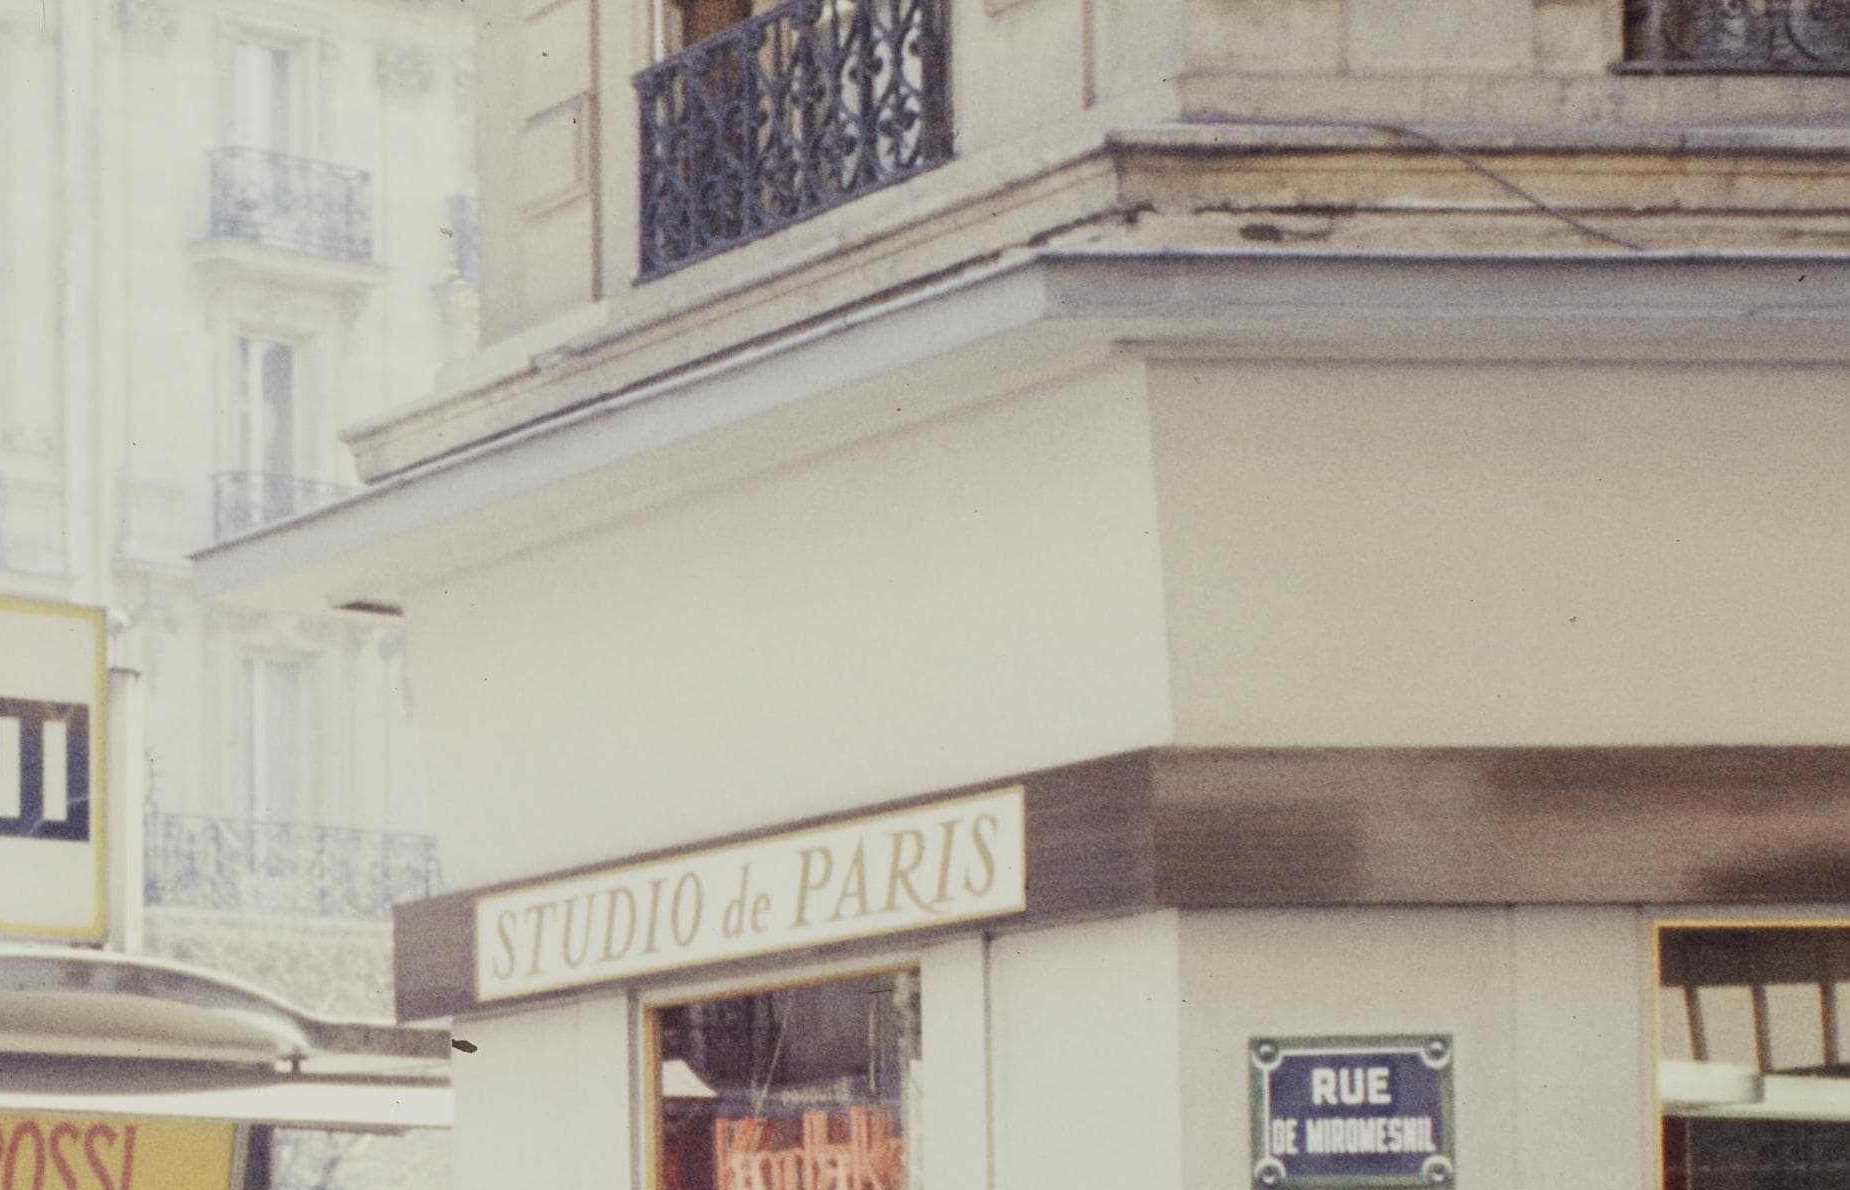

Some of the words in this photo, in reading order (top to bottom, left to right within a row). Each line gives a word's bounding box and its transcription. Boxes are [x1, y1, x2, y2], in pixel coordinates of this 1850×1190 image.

[491, 870, 705, 981] STUDIO
[721, 863, 772, 940] de
[790, 812, 1001, 930] PARIS
[1311, 1066, 1392, 1106] RUE
[1271, 1118, 1299, 1155] DE
[1305, 1116, 1437, 1155] MIROMESNIL
